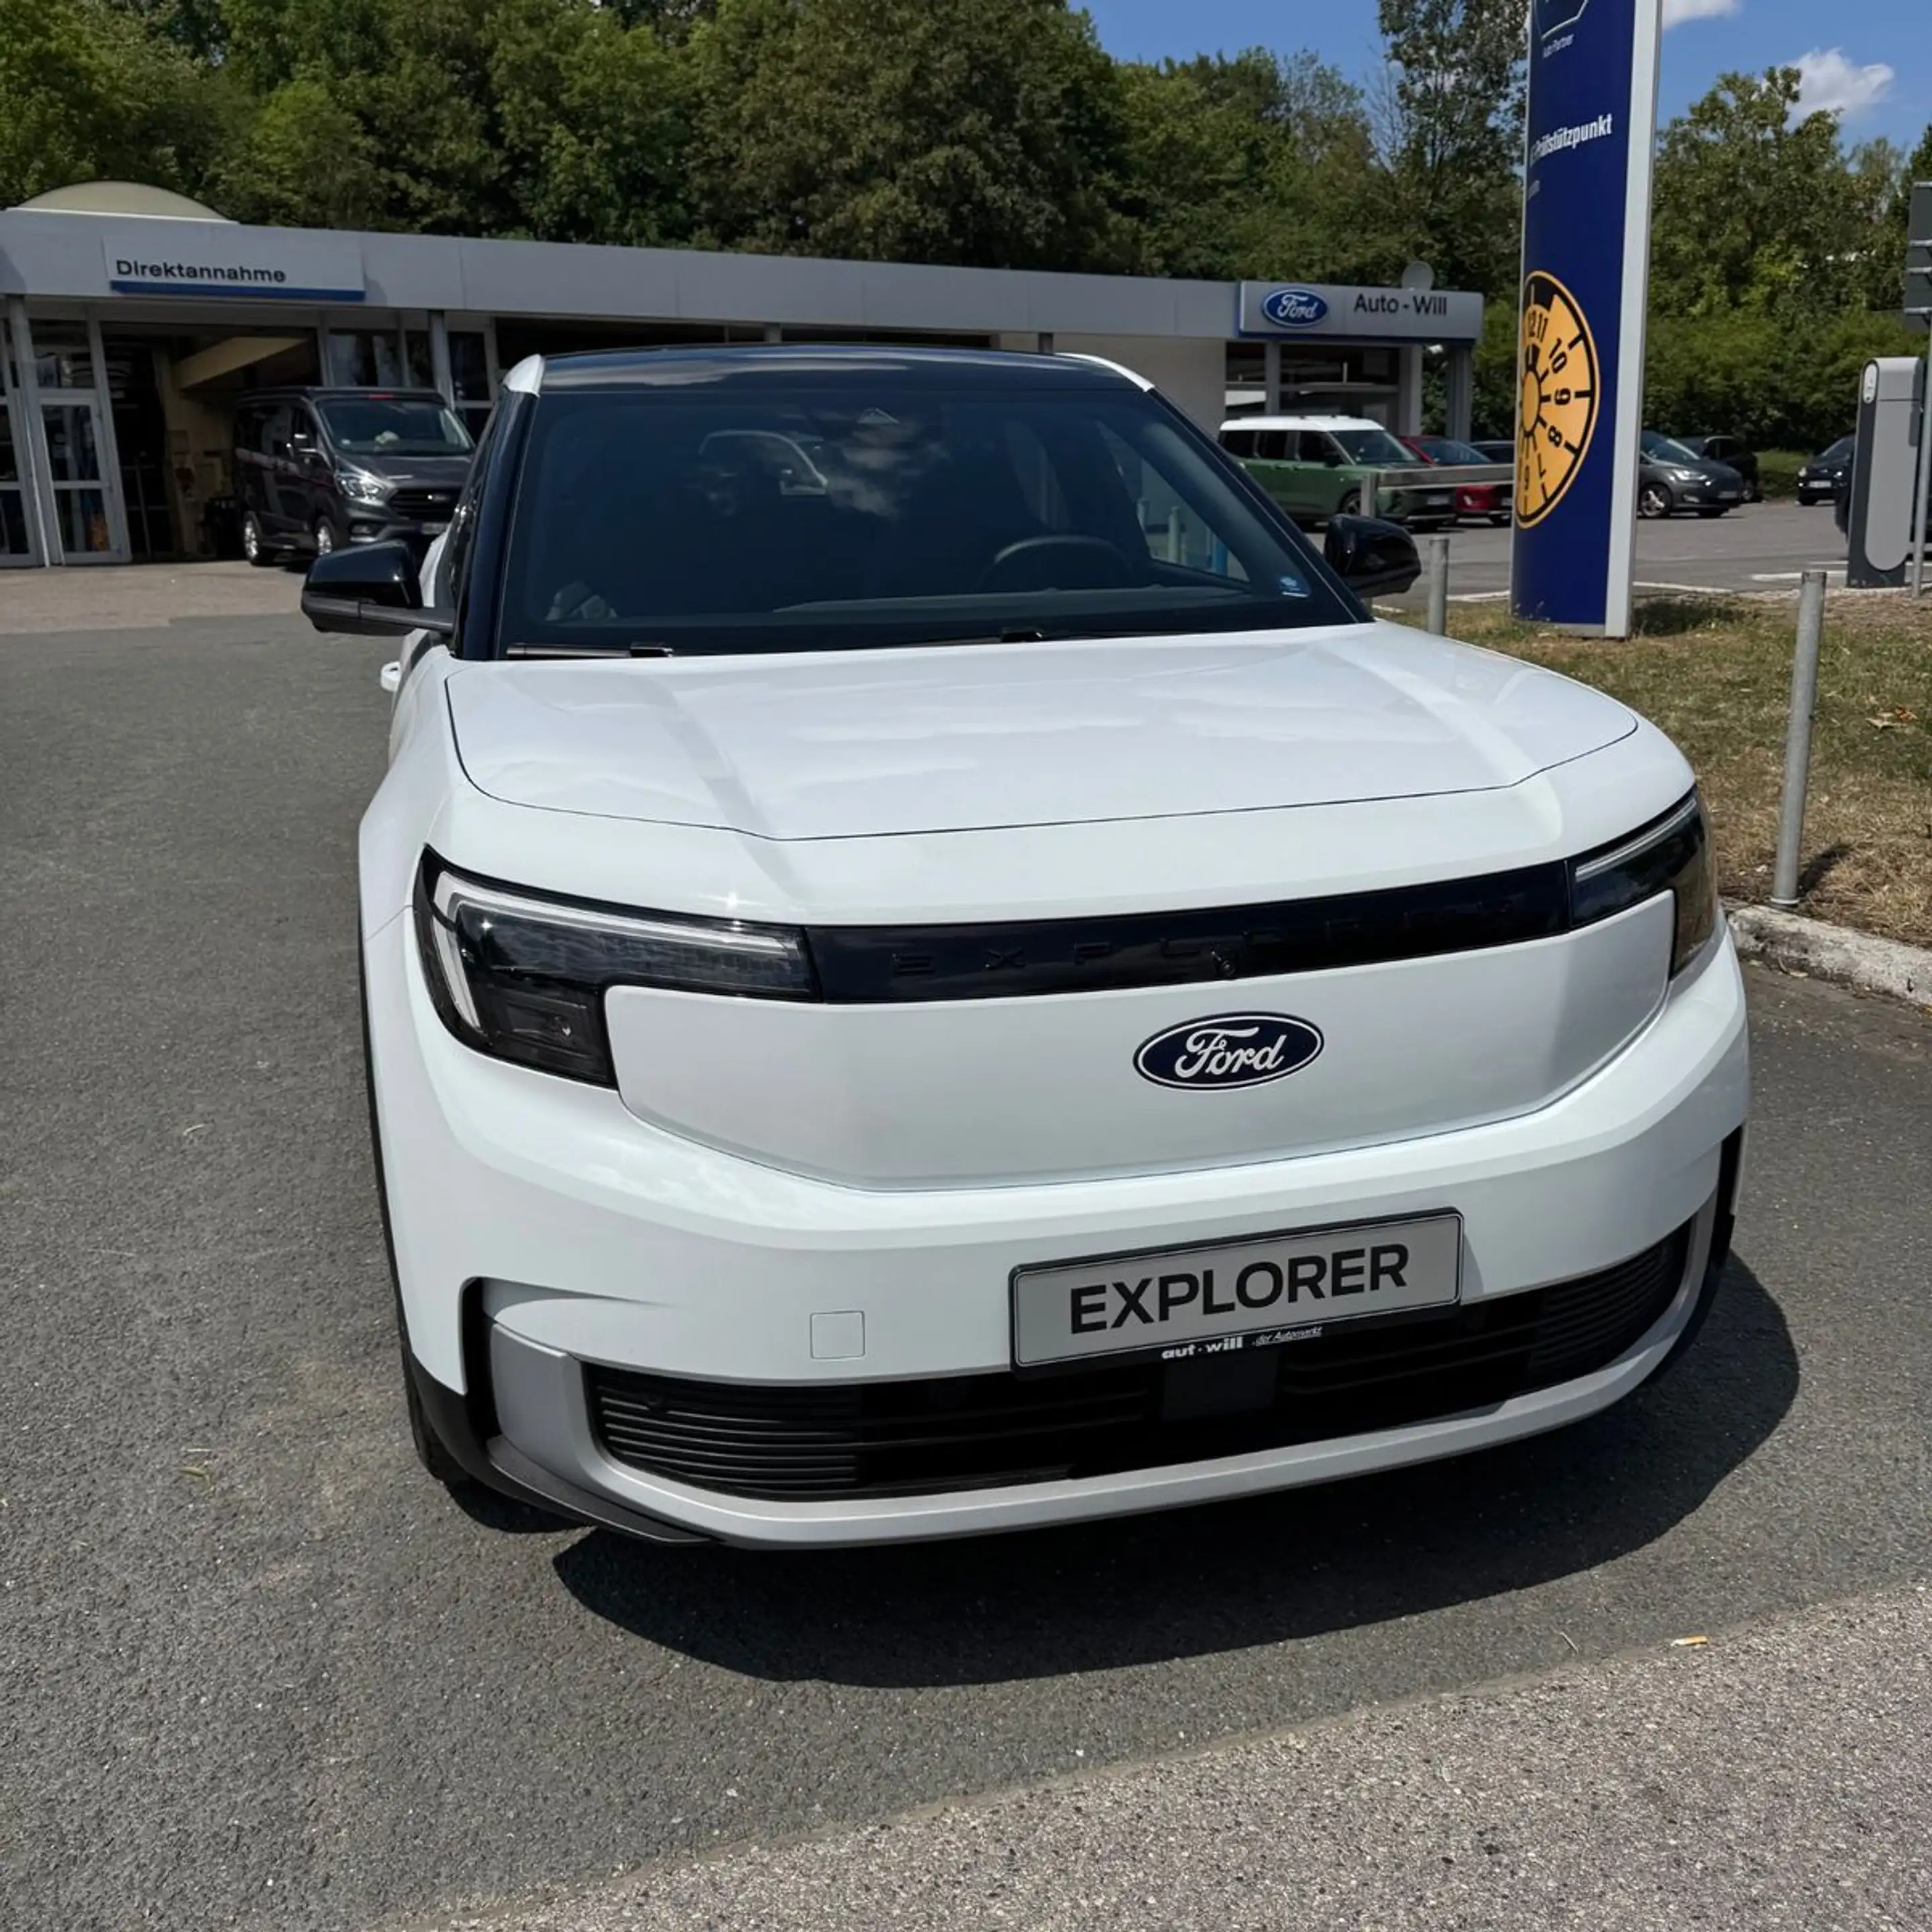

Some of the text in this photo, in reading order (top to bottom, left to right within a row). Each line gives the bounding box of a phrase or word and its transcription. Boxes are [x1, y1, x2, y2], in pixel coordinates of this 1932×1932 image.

[116, 260, 287, 284] Direktannahme
[1277, 294, 1318, 319] Ford
[1549, 337, 1567, 374] 10
[1548, 427, 1564, 447] 8
[1174, 1025, 1285, 1077] Ford
[1070, 1242, 1409, 1335] EXPLORER
